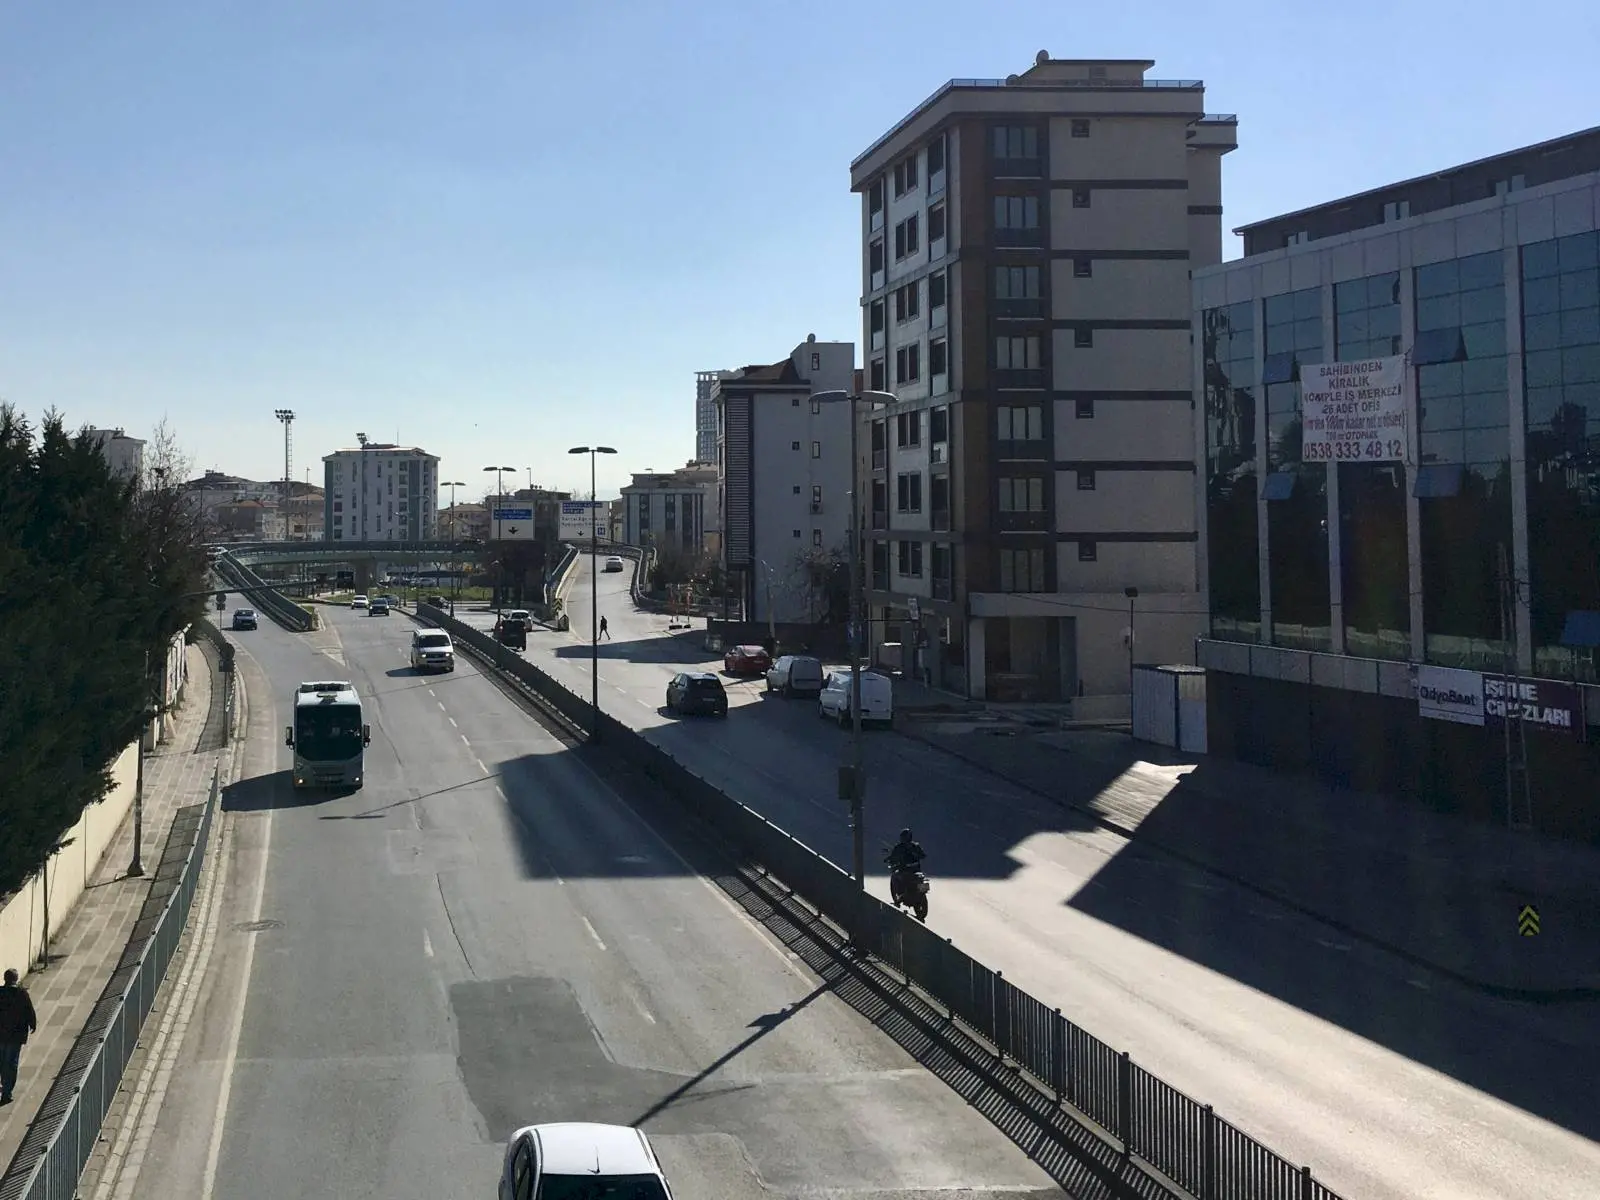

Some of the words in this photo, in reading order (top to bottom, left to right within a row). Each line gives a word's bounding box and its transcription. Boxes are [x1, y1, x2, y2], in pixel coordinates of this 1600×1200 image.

[1336, 402, 1358, 414] ADET
[1304, 441, 1332, 459] 0538
[1335, 441, 1361, 459] 333
[1365, 440, 1382, 458] 48
[1387, 439, 1403, 457] 12
